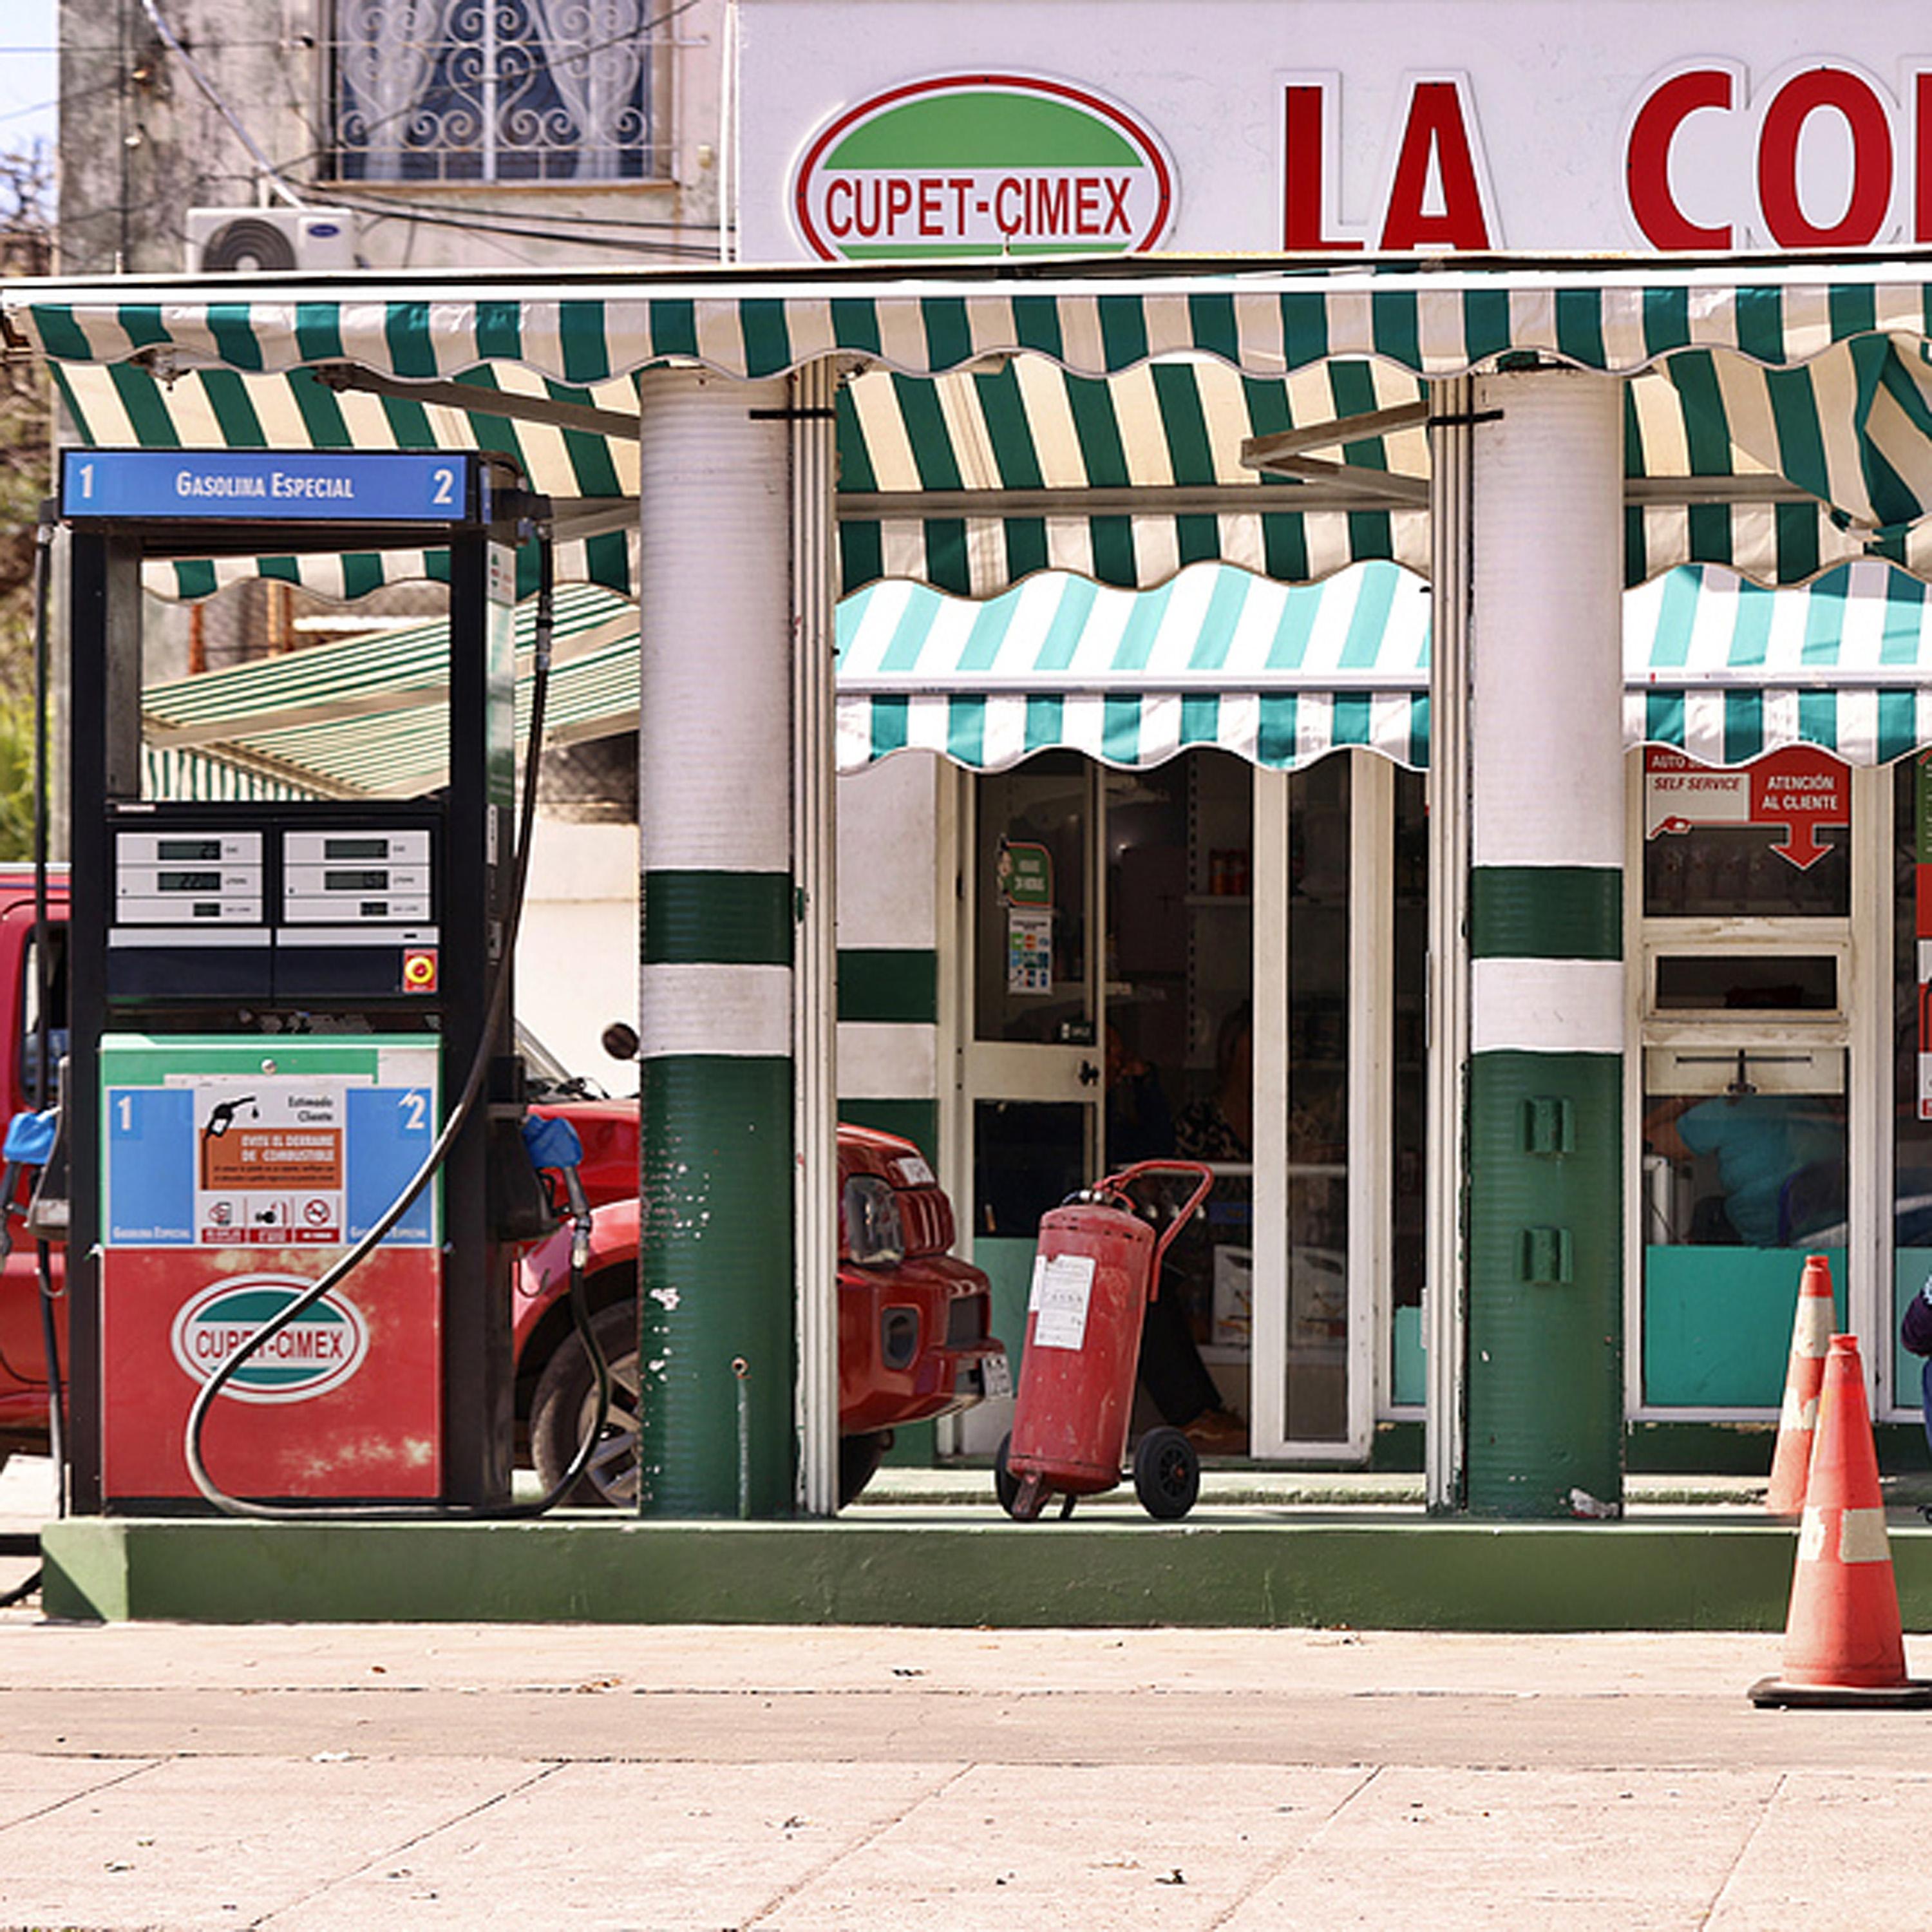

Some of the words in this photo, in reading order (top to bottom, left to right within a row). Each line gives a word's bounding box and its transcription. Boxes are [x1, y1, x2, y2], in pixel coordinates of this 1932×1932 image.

[1283, 82, 1492, 251] LA
[1627, 68, 1932, 251] CO
[825, 178, 1133, 237] CUPET-CIMEX
[80, 464, 93, 498] 1
[176, 471, 266, 497] GASOLINA
[270, 472, 354, 498] ESPECIAL
[432, 469, 453, 504] 2
[1651, 755, 1686, 768] AUTO
[1654, 777, 1684, 791] SELF
[1687, 777, 1739, 791] SERVICE
[1767, 774, 1834, 790] ATENCIÓN
[1761, 795, 1780, 810] AL
[1783, 795, 1839, 810] CLIENTE
[117, 1097, 133, 1130] 1
[406, 1095, 426, 1130] 2
